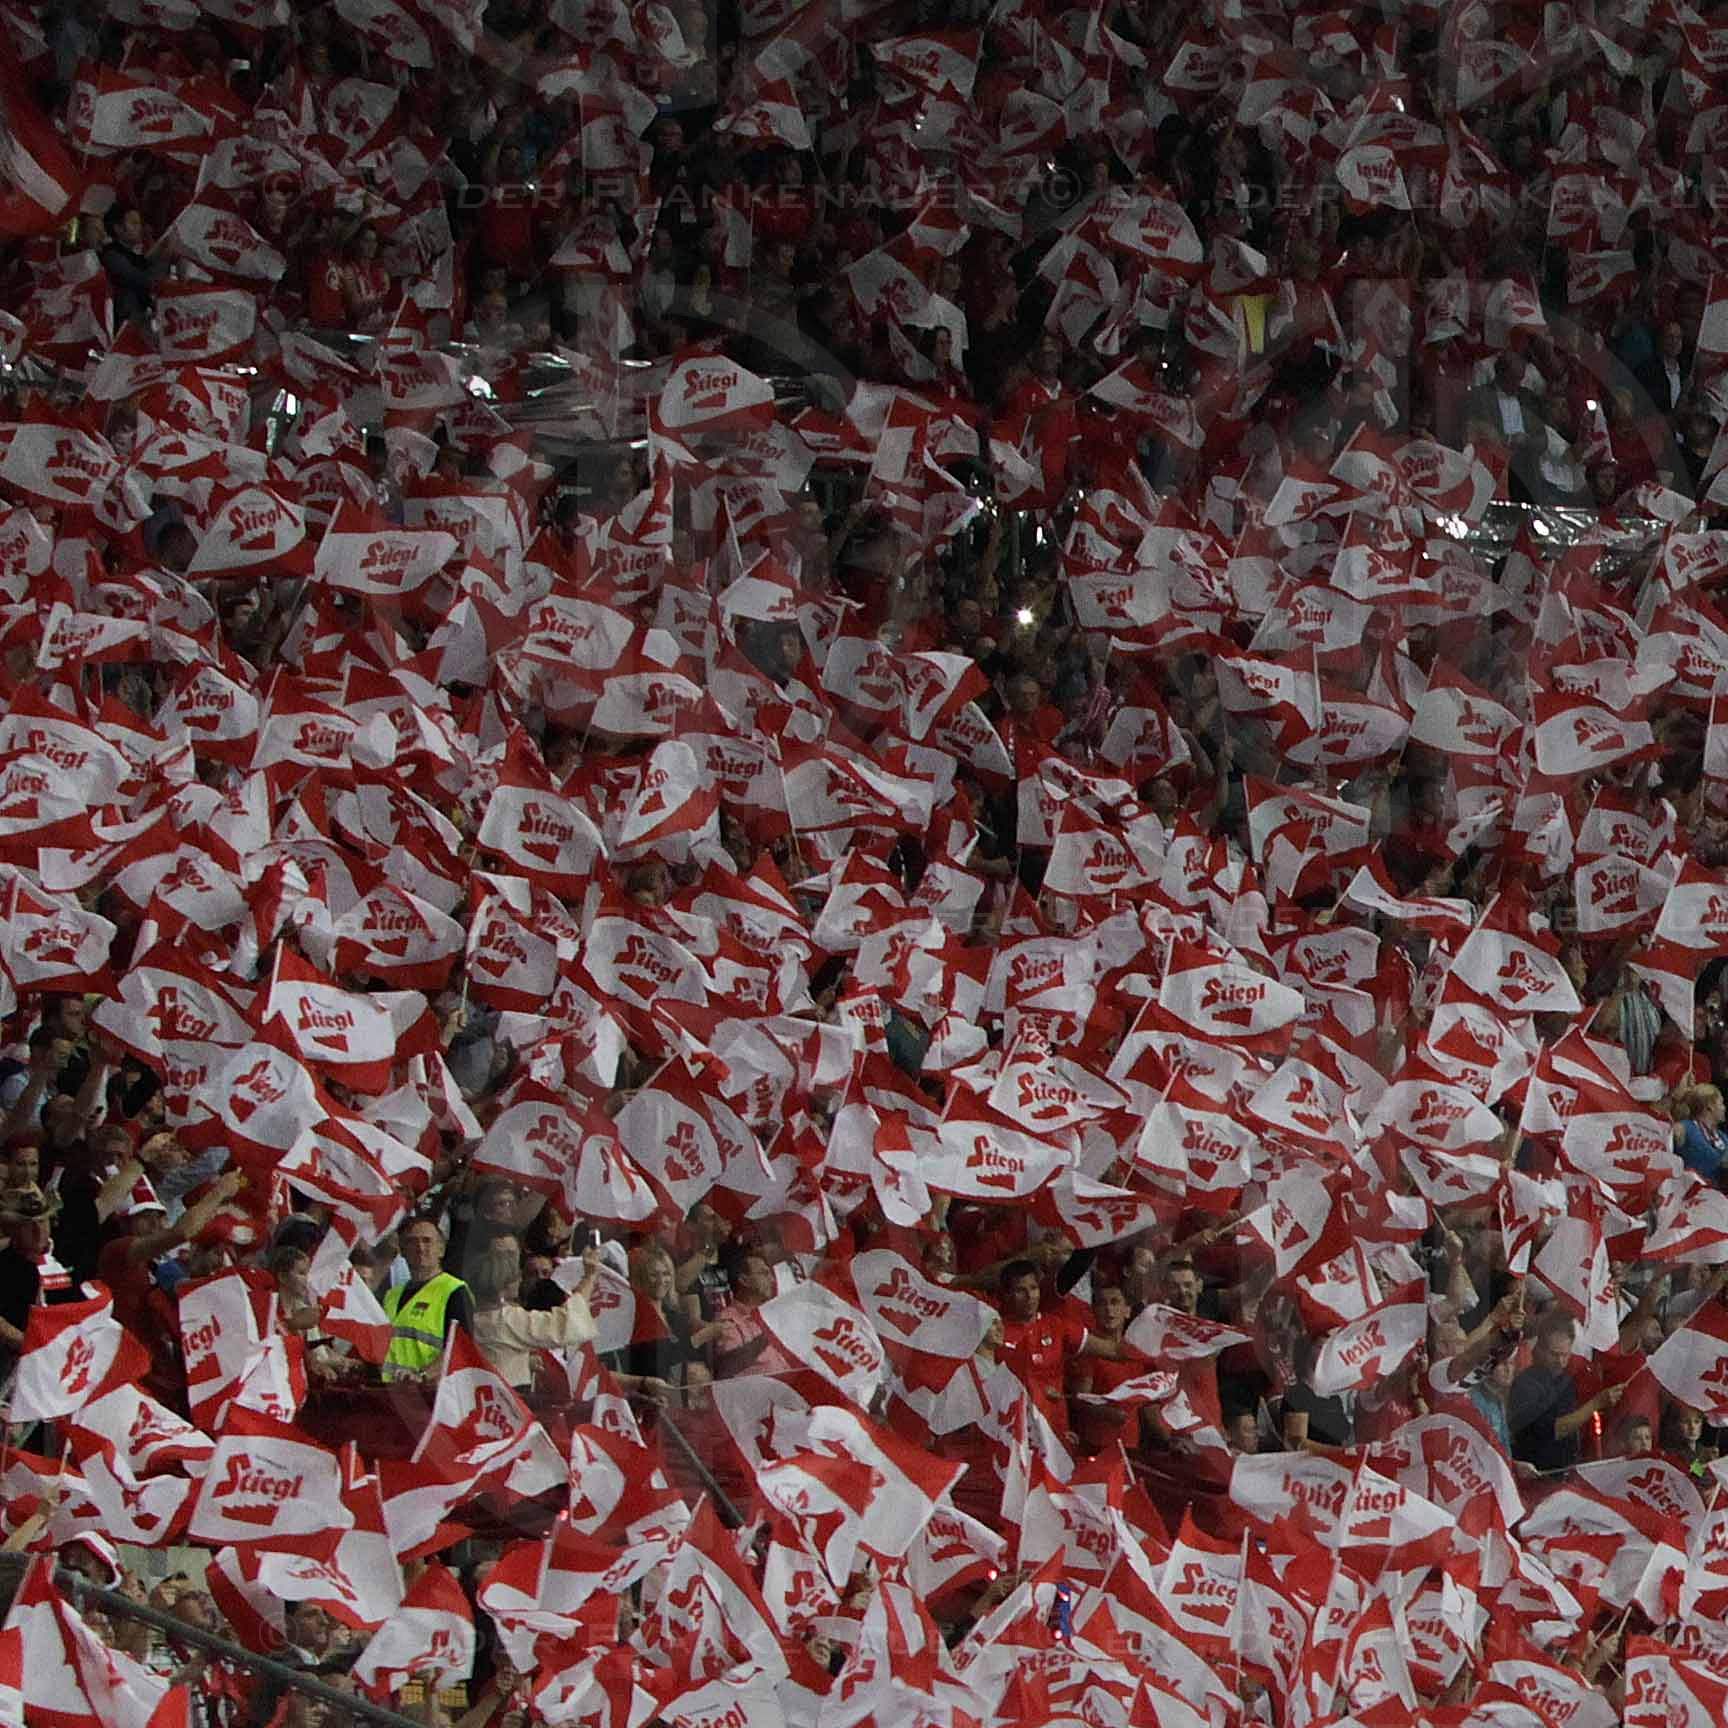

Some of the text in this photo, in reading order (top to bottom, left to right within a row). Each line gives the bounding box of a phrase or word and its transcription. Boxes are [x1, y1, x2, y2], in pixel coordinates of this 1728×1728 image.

[682, 368, 740, 399] Stiegl
[228, 505, 293, 539] Stiegl
[527, 605, 594, 640] Stiegl
[518, 800, 575, 845] Stiegl
[611, 933, 684, 987] Stiegl
[1498, 949, 1558, 995] Stiegl
[1202, 979, 1267, 1008] Stiegl
[1412, 1089, 1476, 1123] Stiegl
[965, 1133, 1026, 1174] Stiegl
[1182, 1119, 1244, 1162] Stiegl
[873, 1268, 951, 1321] Stiegl
[812, 1317, 880, 1372] Stiegl
[211, 1452, 304, 1500] Stiegl
[1447, 1435, 1495, 1496] Stiegl
[1627, 1466, 1689, 1522] Stiegl
[1514, 1676, 1580, 1723] Stiegl
